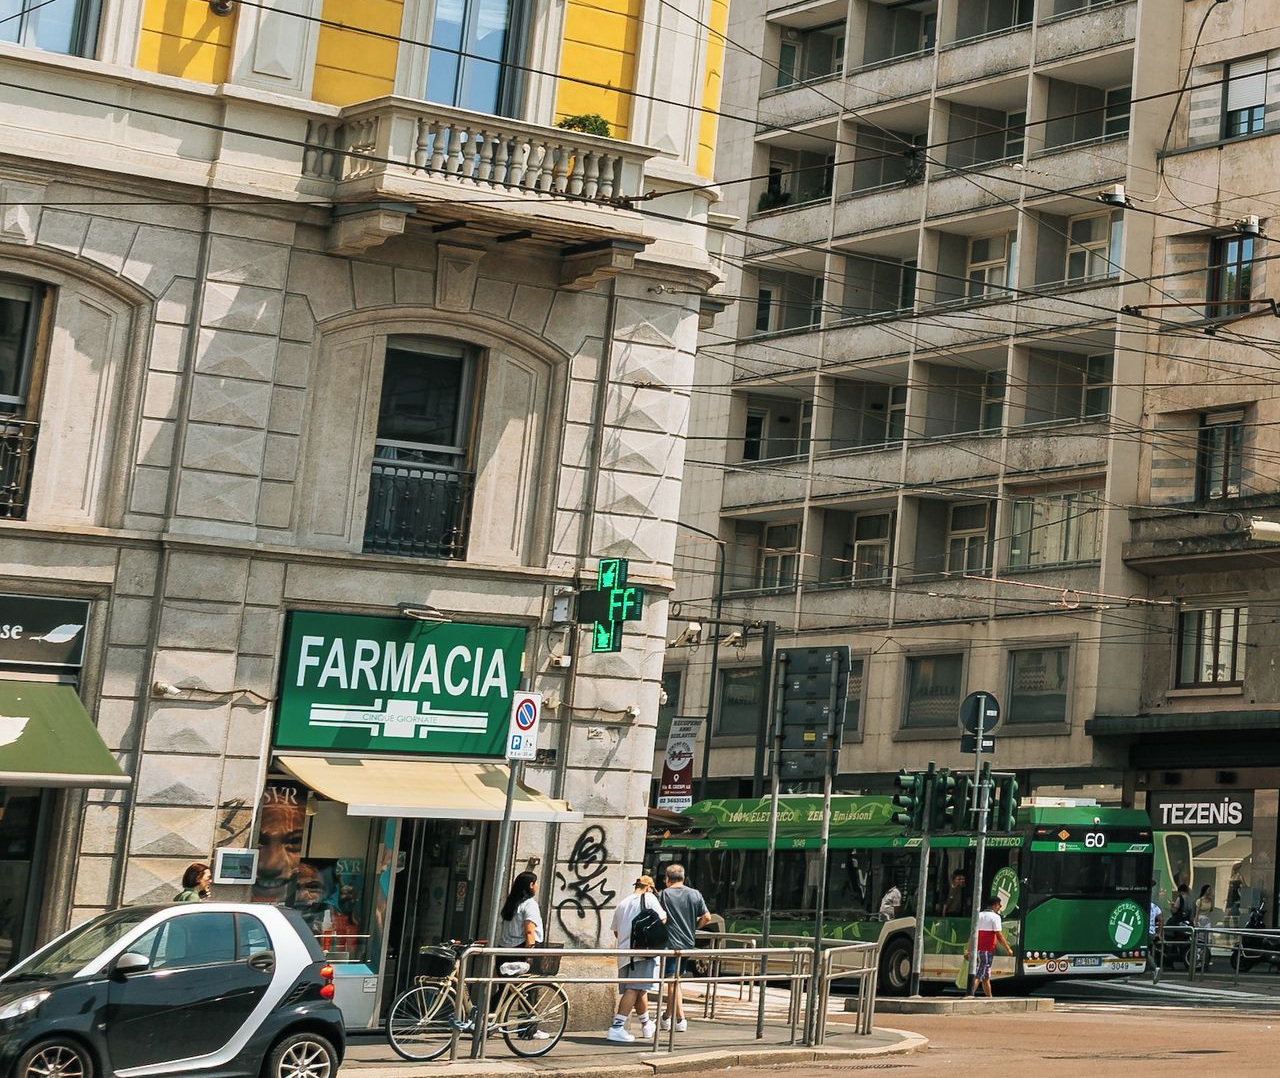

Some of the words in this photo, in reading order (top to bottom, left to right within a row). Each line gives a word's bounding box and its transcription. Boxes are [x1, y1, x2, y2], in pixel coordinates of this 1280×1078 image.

[296, 636, 508, 698] FARMACIA
[362, 713, 394, 722] CINQUE
[397, 714, 438, 723] GIORNATE
[263, 786, 298, 805] SVR
[729, 812, 750, 822] 100%
[751, 812, 794, 822] ELETRICO
[808, 811, 824, 821] ZER
[1085, 832, 1105, 848] 60
[1109, 903, 1137, 926] ELECTRIC
[1111, 962, 1129, 971] 3049
